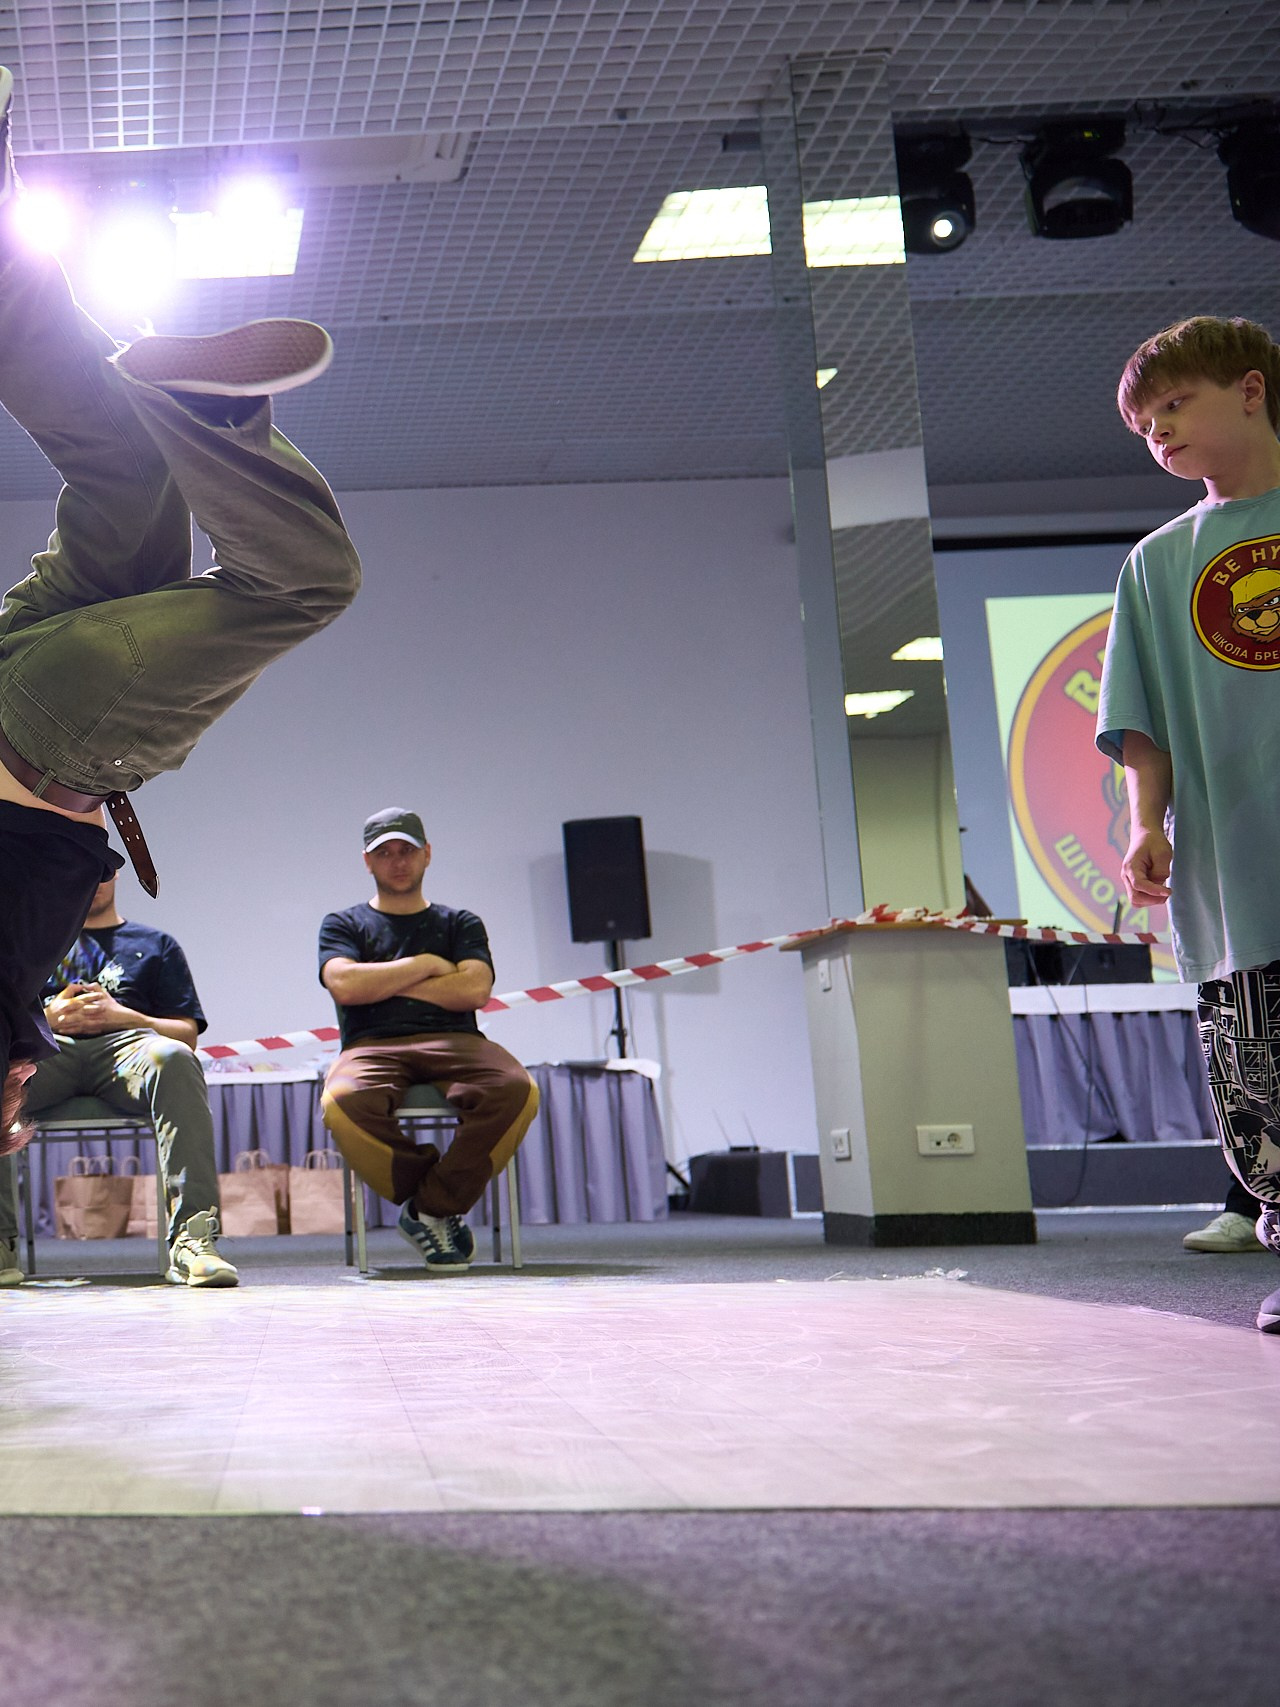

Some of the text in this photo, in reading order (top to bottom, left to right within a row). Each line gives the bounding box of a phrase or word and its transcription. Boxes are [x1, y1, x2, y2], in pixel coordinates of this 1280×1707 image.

[1212, 558, 1241, 586] BE
[1211, 631, 1248, 659] ШКОЛА
[1064, 648, 1105, 715] B
